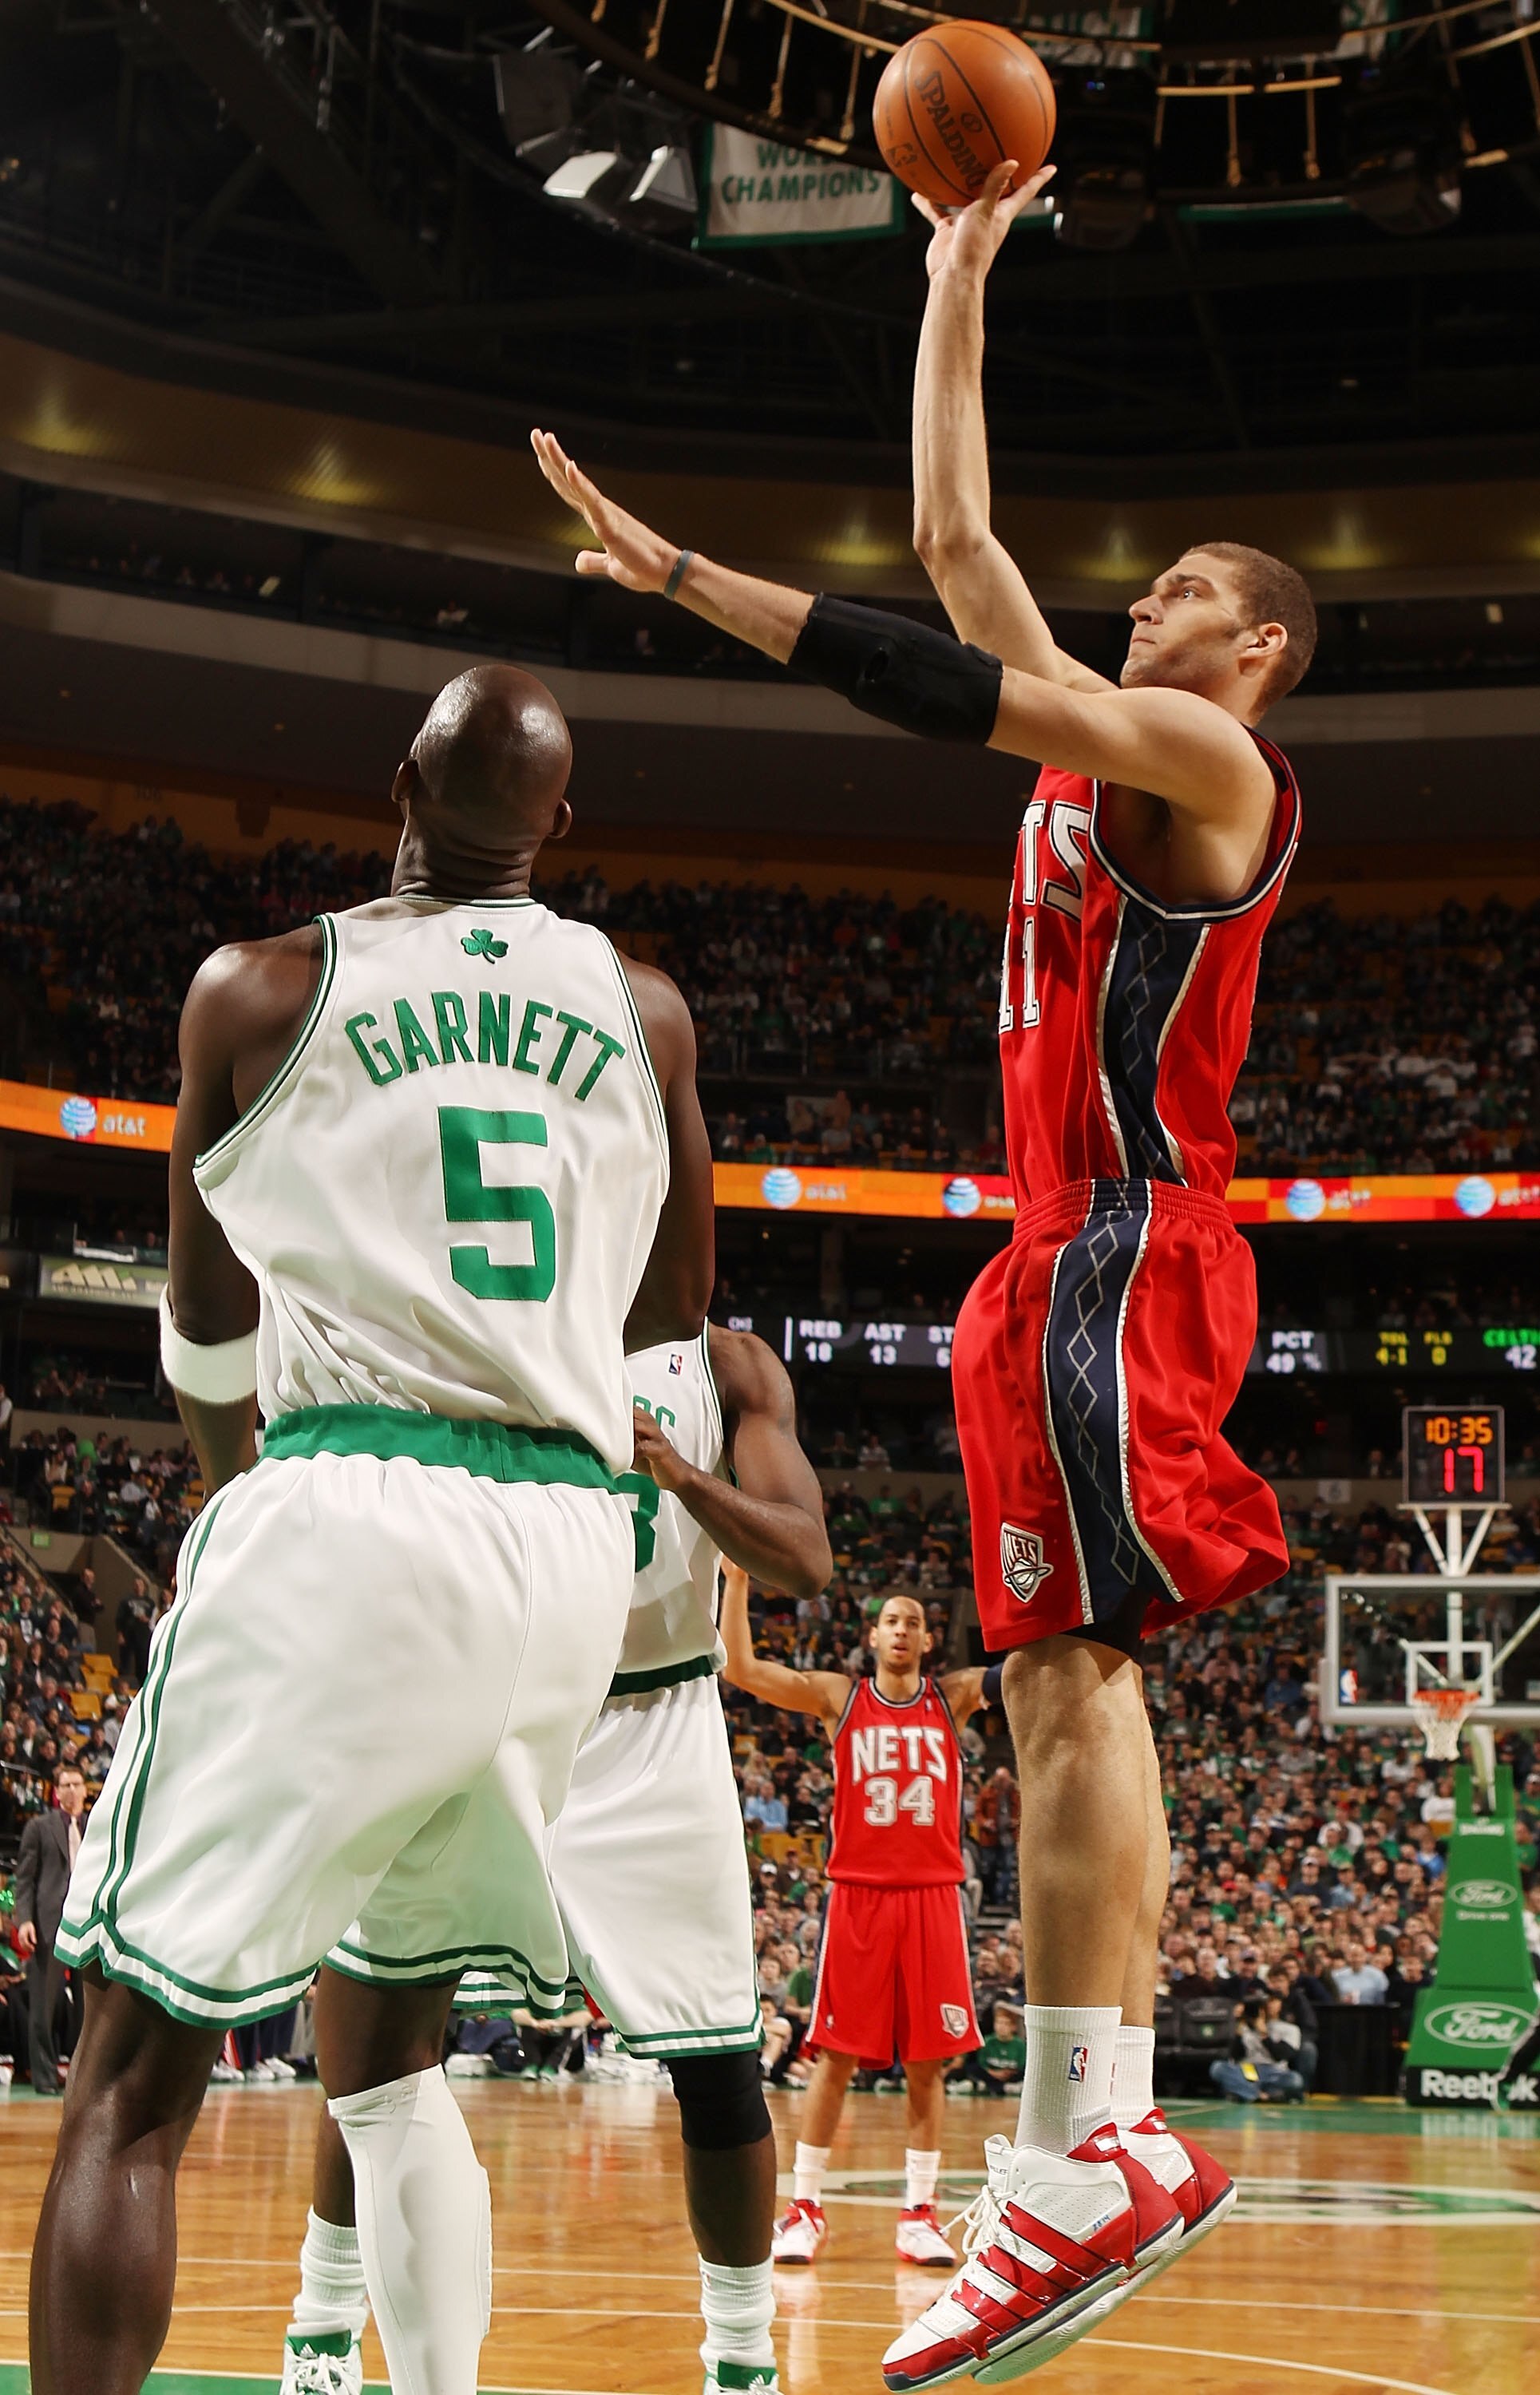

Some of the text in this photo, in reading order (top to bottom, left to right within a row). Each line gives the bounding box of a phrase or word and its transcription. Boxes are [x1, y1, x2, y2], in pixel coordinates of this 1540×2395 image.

[915, 70, 991, 191] SPALDING
[721, 169, 881, 204] CHAMPIONS
[344, 991, 626, 1102] GARNETT
[437, 1105, 556, 1303] 5
[799, 1320, 842, 1339] REB
[865, 1323, 906, 1342] AST
[1272, 1331, 1315, 1349] PCT
[870, 1344, 897, 1365] 13
[1505, 1344, 1538, 1369] 42
[1426, 1415, 1494, 1445] 10:35
[1443, 1446, 1484, 1493] 17
[1004, 1531, 1037, 1570] NETS
[852, 1724, 948, 1786] NETS
[864, 1775, 936, 1827] 34
[1443, 2008, 1521, 2041] Ford
[1420, 2068, 1539, 2102] Reebk
